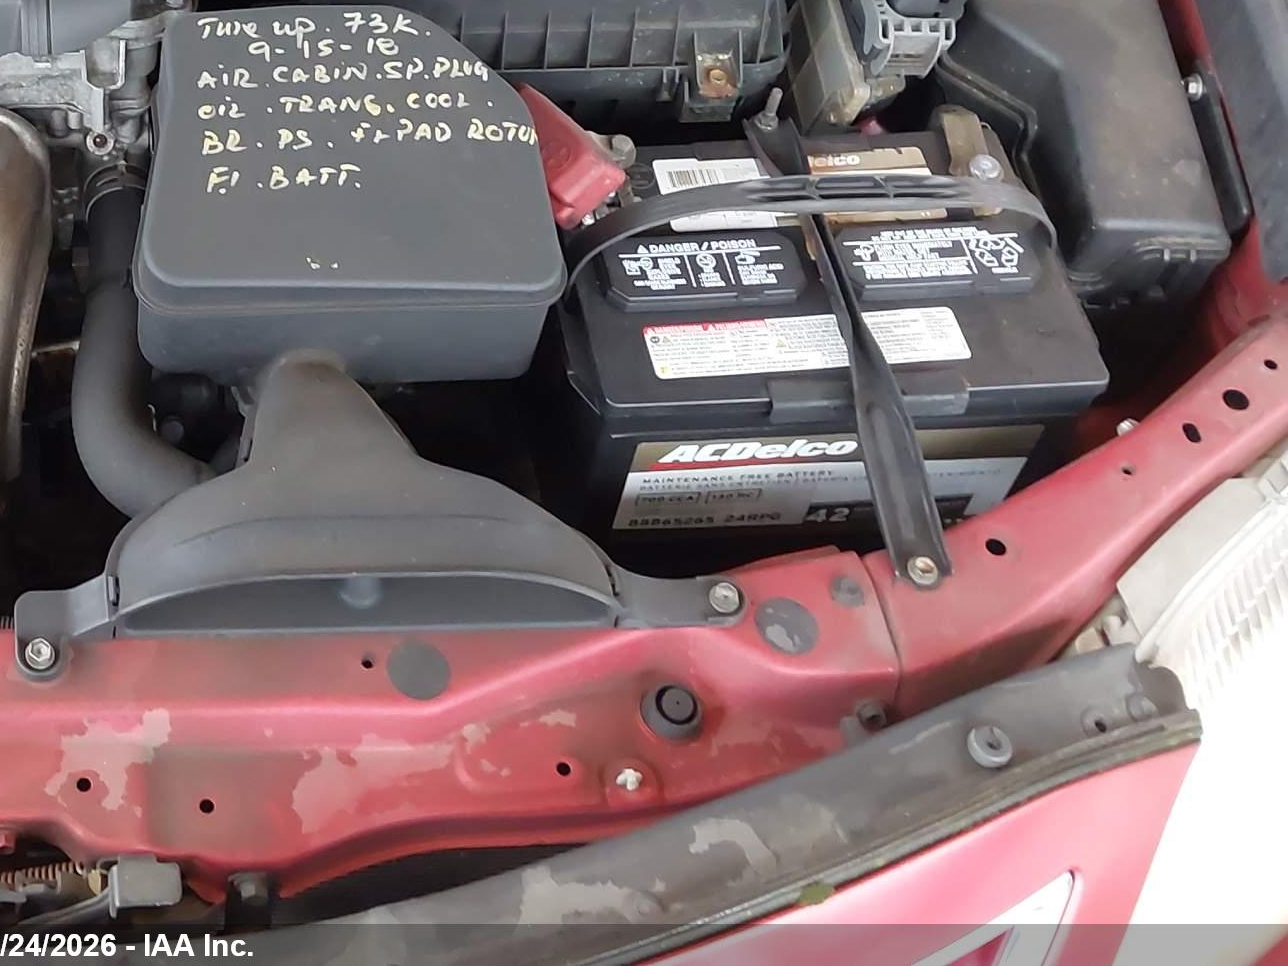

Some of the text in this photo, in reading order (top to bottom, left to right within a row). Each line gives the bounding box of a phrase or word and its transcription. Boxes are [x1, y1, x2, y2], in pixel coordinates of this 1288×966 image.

[397, 118, 452, 143] PAD
[648, 242, 699, 254] DANGER
[711, 239, 757, 251] POISON
[657, 438, 859, 464] ACDelco
[805, 507, 851, 523] 42
